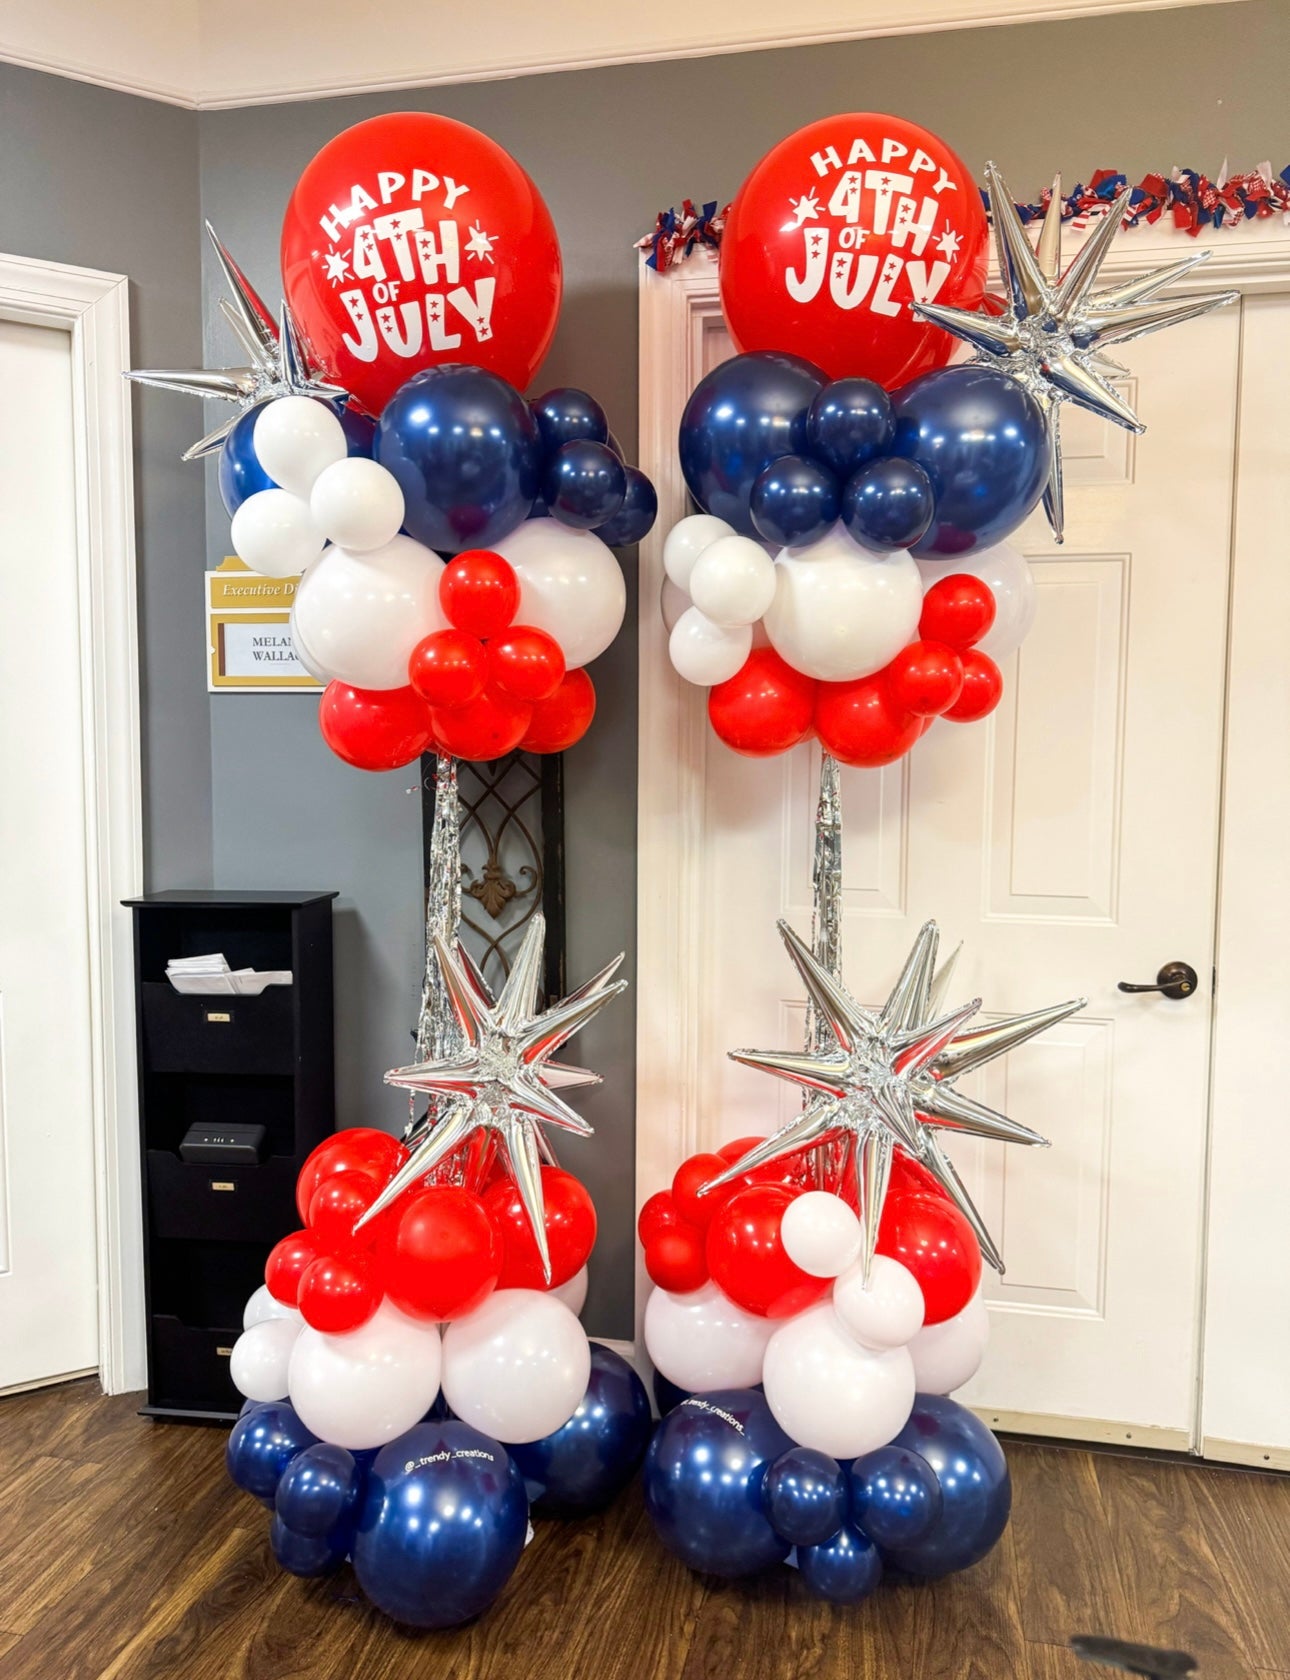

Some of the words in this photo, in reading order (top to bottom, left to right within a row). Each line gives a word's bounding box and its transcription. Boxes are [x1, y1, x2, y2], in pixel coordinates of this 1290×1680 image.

[809, 138, 957, 194] HAPPY
[320, 169, 470, 243] HAPPY
[828, 170, 939, 256] 4TH
[838, 227, 870, 249] OF
[353, 208, 461, 285] 4TH
[785, 227, 951, 322] JULY
[339, 277, 496, 362] JULY
[372, 280, 401, 303] OF
[223, 583, 281, 596] Executive
